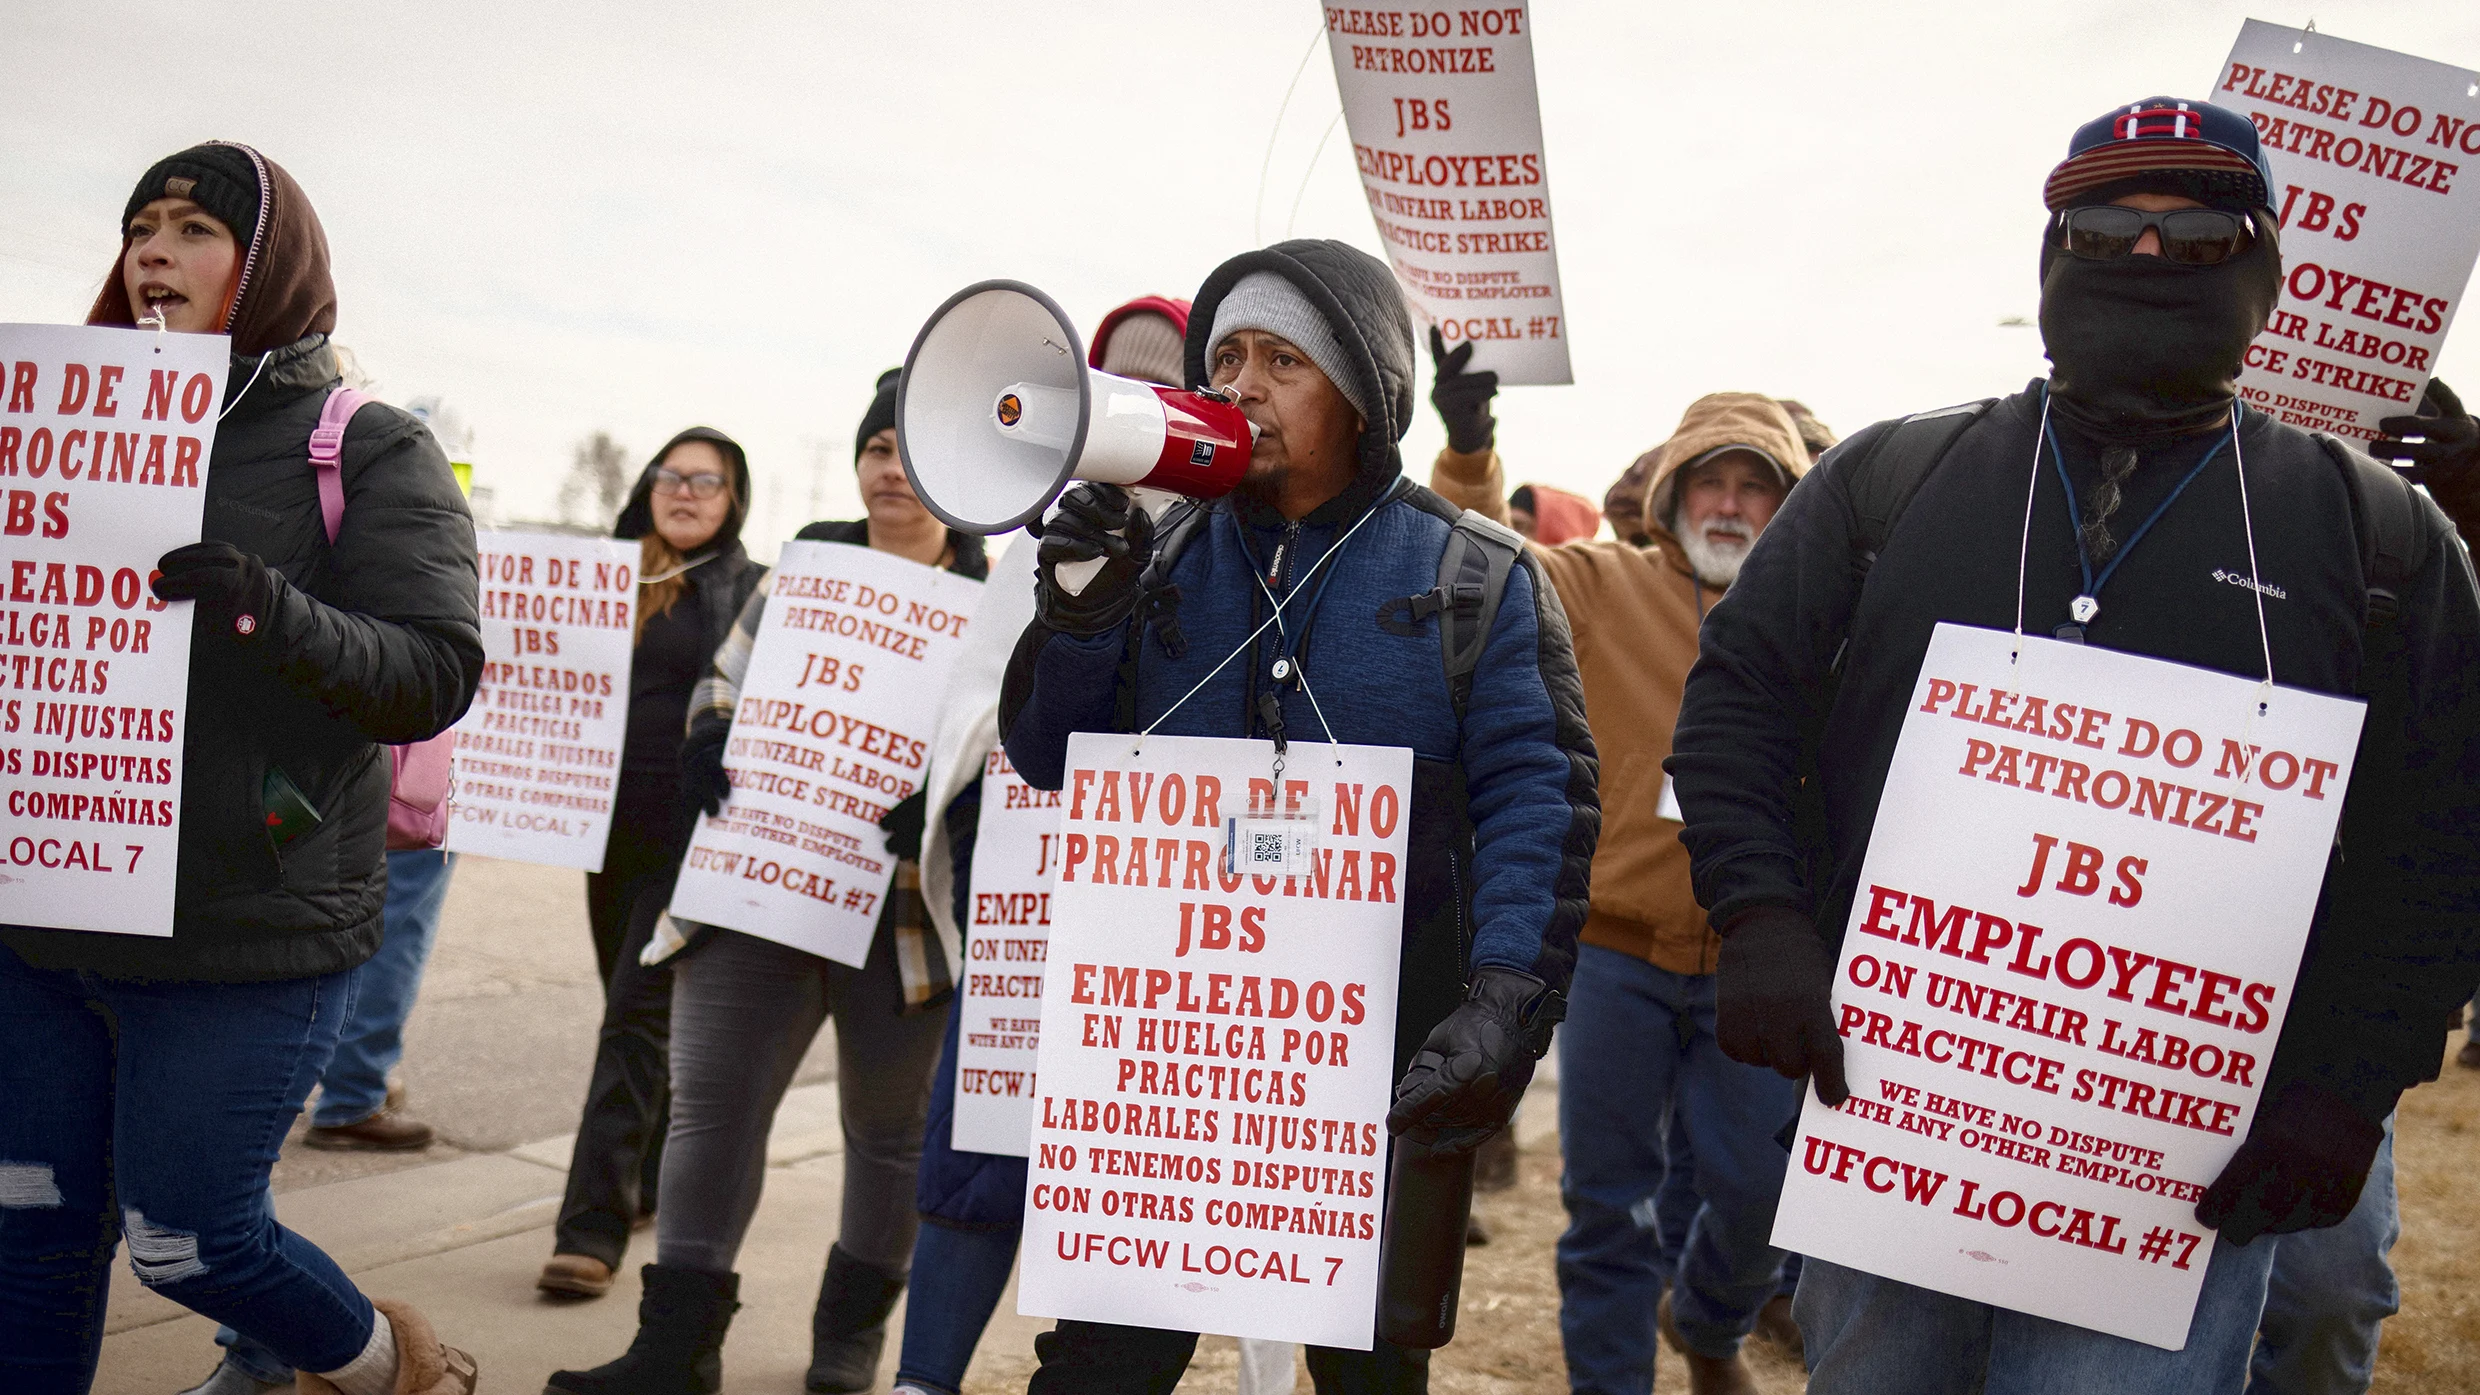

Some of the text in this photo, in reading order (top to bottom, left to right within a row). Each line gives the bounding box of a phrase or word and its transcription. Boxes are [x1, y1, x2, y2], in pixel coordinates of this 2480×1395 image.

[1327, 7, 1523, 38] PLEASE DO NOT
[1352, 45, 1495, 74] PATRONIZE
[1393, 97, 1450, 138] JBS
[2222, 62, 2359, 122] PLEASE
[2358, 96, 2422, 137] DO
[1354, 144, 1540, 187] EMPLOYEES
[2250, 112, 2459, 195] PATRONIZE
[1460, 198, 1547, 220] LABOR
[2279, 184, 2367, 242] JBS
[1457, 230, 1549, 254] STRIKE
[1456, 270, 1520, 285] DISPUTE
[1466, 285, 1552, 299] EMPLOYER
[2281, 262, 2448, 335] OYEES
[1442, 316, 1560, 341] OCAL #7
[2314, 322, 2429, 372] LABOR
[57, 363, 125, 418] DE
[141, 369, 213, 424] NO
[2240, 386, 2270, 403] NO
[2274, 394, 2359, 423] DISPUTE
[2292, 357, 2417, 404] STRIKE
[0, 489, 70, 540] BS
[548, 558, 580, 589] DE
[594, 562, 631, 593] NO
[2227, 573, 2287, 600] Columbia
[775, 575, 968, 640] PLEASE DO NOT
[2080, 604, 2089, 614] 7
[86, 616, 152, 654] POR
[513, 628, 559, 657] JBS
[784, 606, 928, 662] PATRONIZE
[797, 653, 865, 692] JBS
[34, 702, 174, 743] INJUSTAS
[484, 711, 581, 740] PRACTICAS
[498, 690, 562, 715] HUELGA
[570, 697, 604, 719] POR
[738, 698, 927, 770] EMPLOYEES
[1919, 677, 2338, 801] PLEASE DO NOT
[32, 750, 171, 786] DISPUTAS
[750, 739, 825, 773] UNFAIR
[831, 757, 914, 801] LABOR
[1958, 738, 2264, 844] PATRONIZE
[8, 789, 173, 828] COMPAÑIAS
[502, 811, 571, 837] LOCAL
[579, 822, 591, 838] 7
[1069, 769, 1399, 839] FAVOR DE NO
[751, 824, 798, 847] OTHER
[772, 814, 795, 830] NO
[798, 820, 863, 851] DISPUTE
[125, 845, 143, 874] 7
[689, 846, 877, 917] UFCW LOCAL #7
[2017, 833, 2149, 908] JBS
[971, 939, 1048, 963] ON UNF
[1175, 902, 1266, 957] JBS
[1859, 884, 2276, 1034] EMPLOYEES
[969, 974, 1044, 998] PRACTI
[1071, 963, 1366, 1026] EMPLEADOS
[1000, 1035, 1025, 1050] ANY
[1082, 1013, 1350, 1067] EN HUELGA POR
[1847, 954, 2256, 1088] ON UNFAIR LABOR
[962, 1068, 1024, 1098] UFCW
[1116, 1058, 1307, 1108] PRACTICAS
[1839, 1003, 2241, 1137] PRACTICE STRIKE
[1042, 1097, 1377, 1156] LABORALES INJUSTAS
[1879, 1078, 2165, 1171] WE HAVE NO DISPUTE
[1038, 1143, 1375, 1199] NO TENEMOS DISPUTAS
[1896, 1111, 1955, 1142] ANY
[1958, 1128, 2050, 1168] OTHER
[2057, 1155, 2207, 1203] EMPLOYER
[1033, 1183, 1375, 1241] CON OTRAS COMPAÑIAS
[1802, 1136, 2202, 1271] UFCW LOCAL #7
[1056, 1231, 1344, 1286] UFCW LOCAL 7
